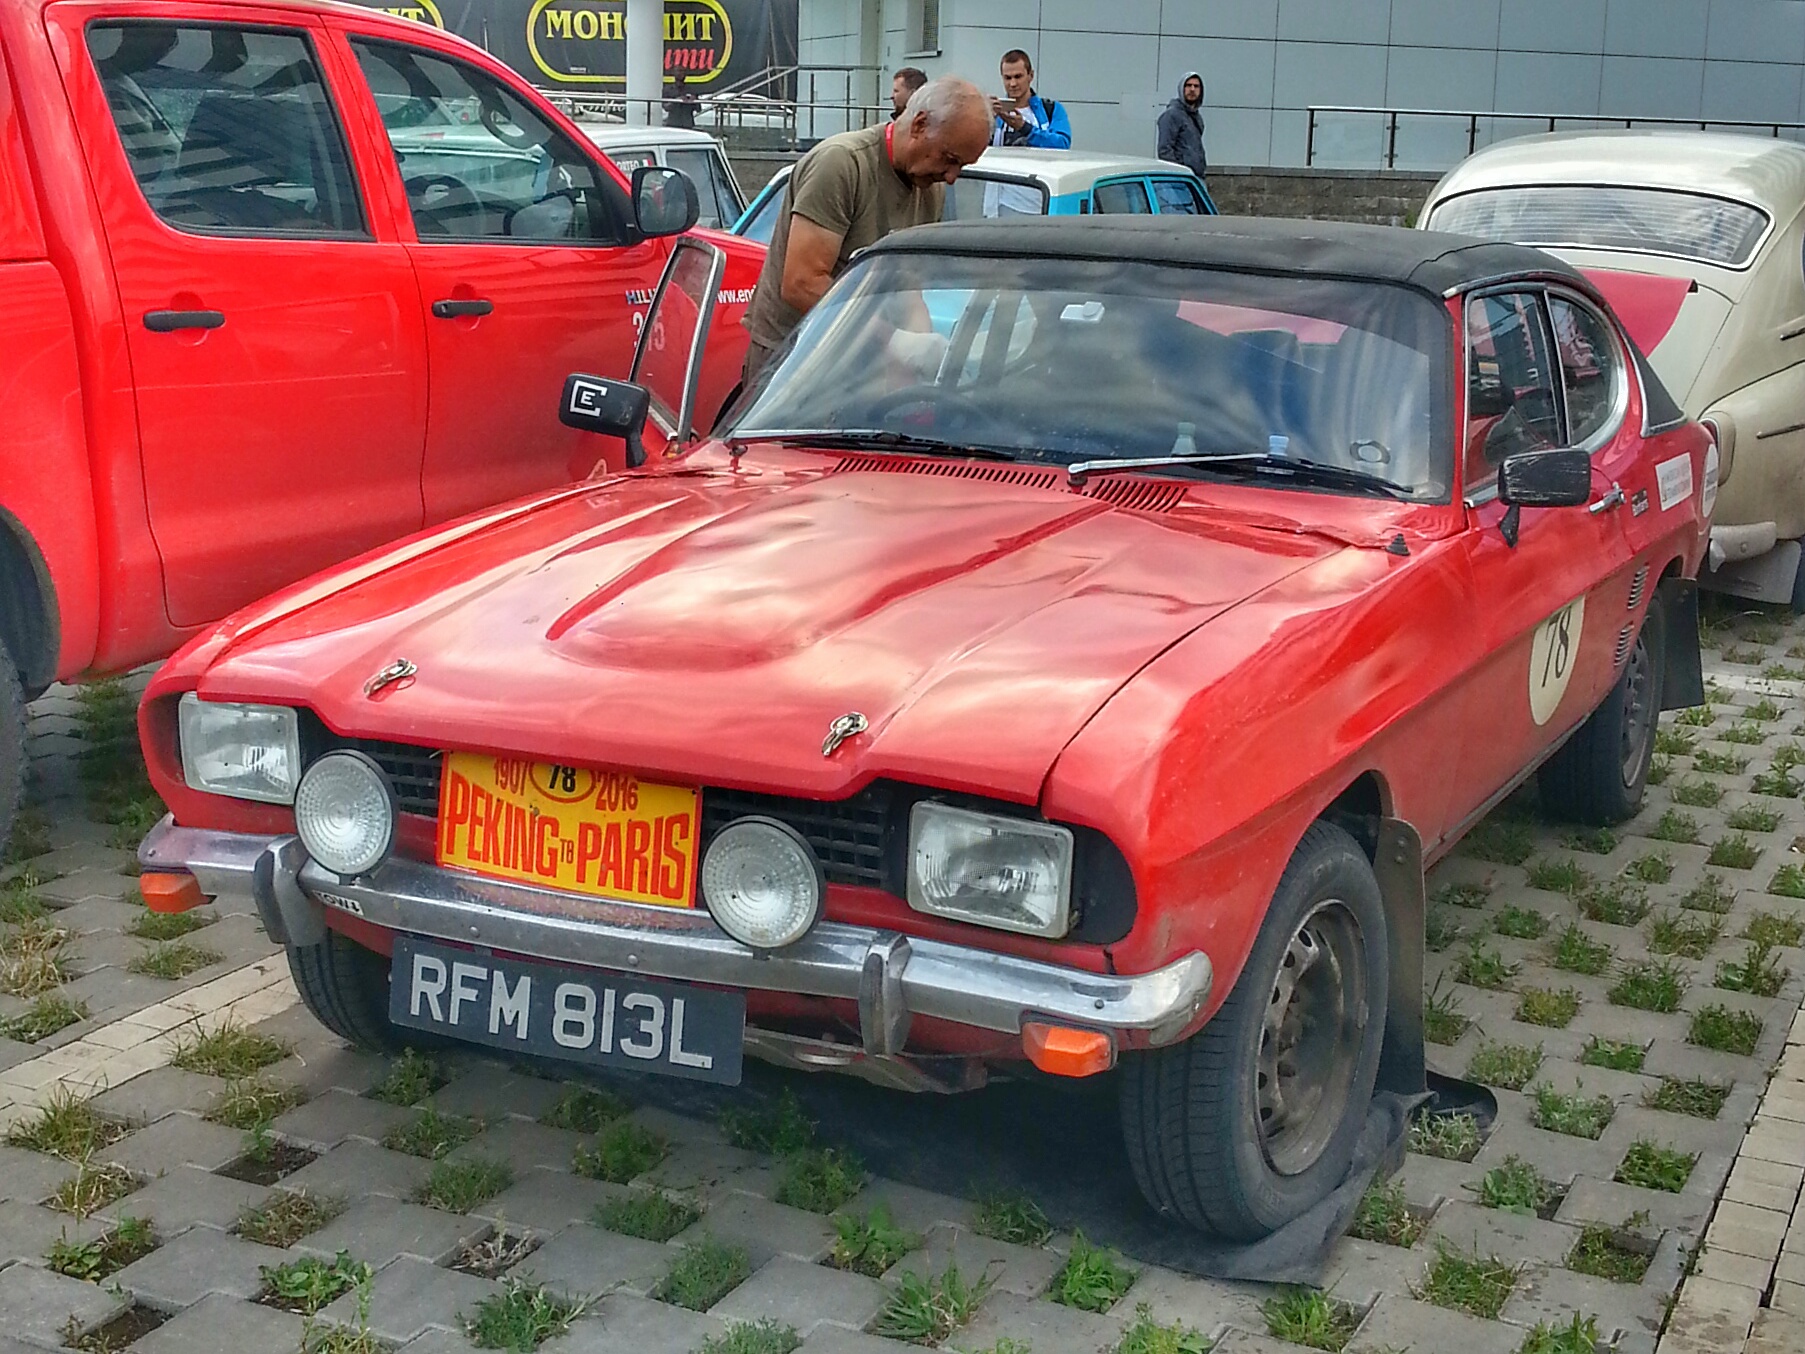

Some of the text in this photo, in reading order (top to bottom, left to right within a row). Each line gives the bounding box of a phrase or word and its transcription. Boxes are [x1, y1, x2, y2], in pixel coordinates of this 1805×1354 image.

[545, 9, 717, 41] МОНЛИТ
[1542, 604, 1571, 688] 78
[493, 758, 639, 812] 1907 78 2016
[446, 770, 560, 879] PEKING
[576, 812, 690, 900] PARIS
[410, 953, 713, 1069] RFM 813L
